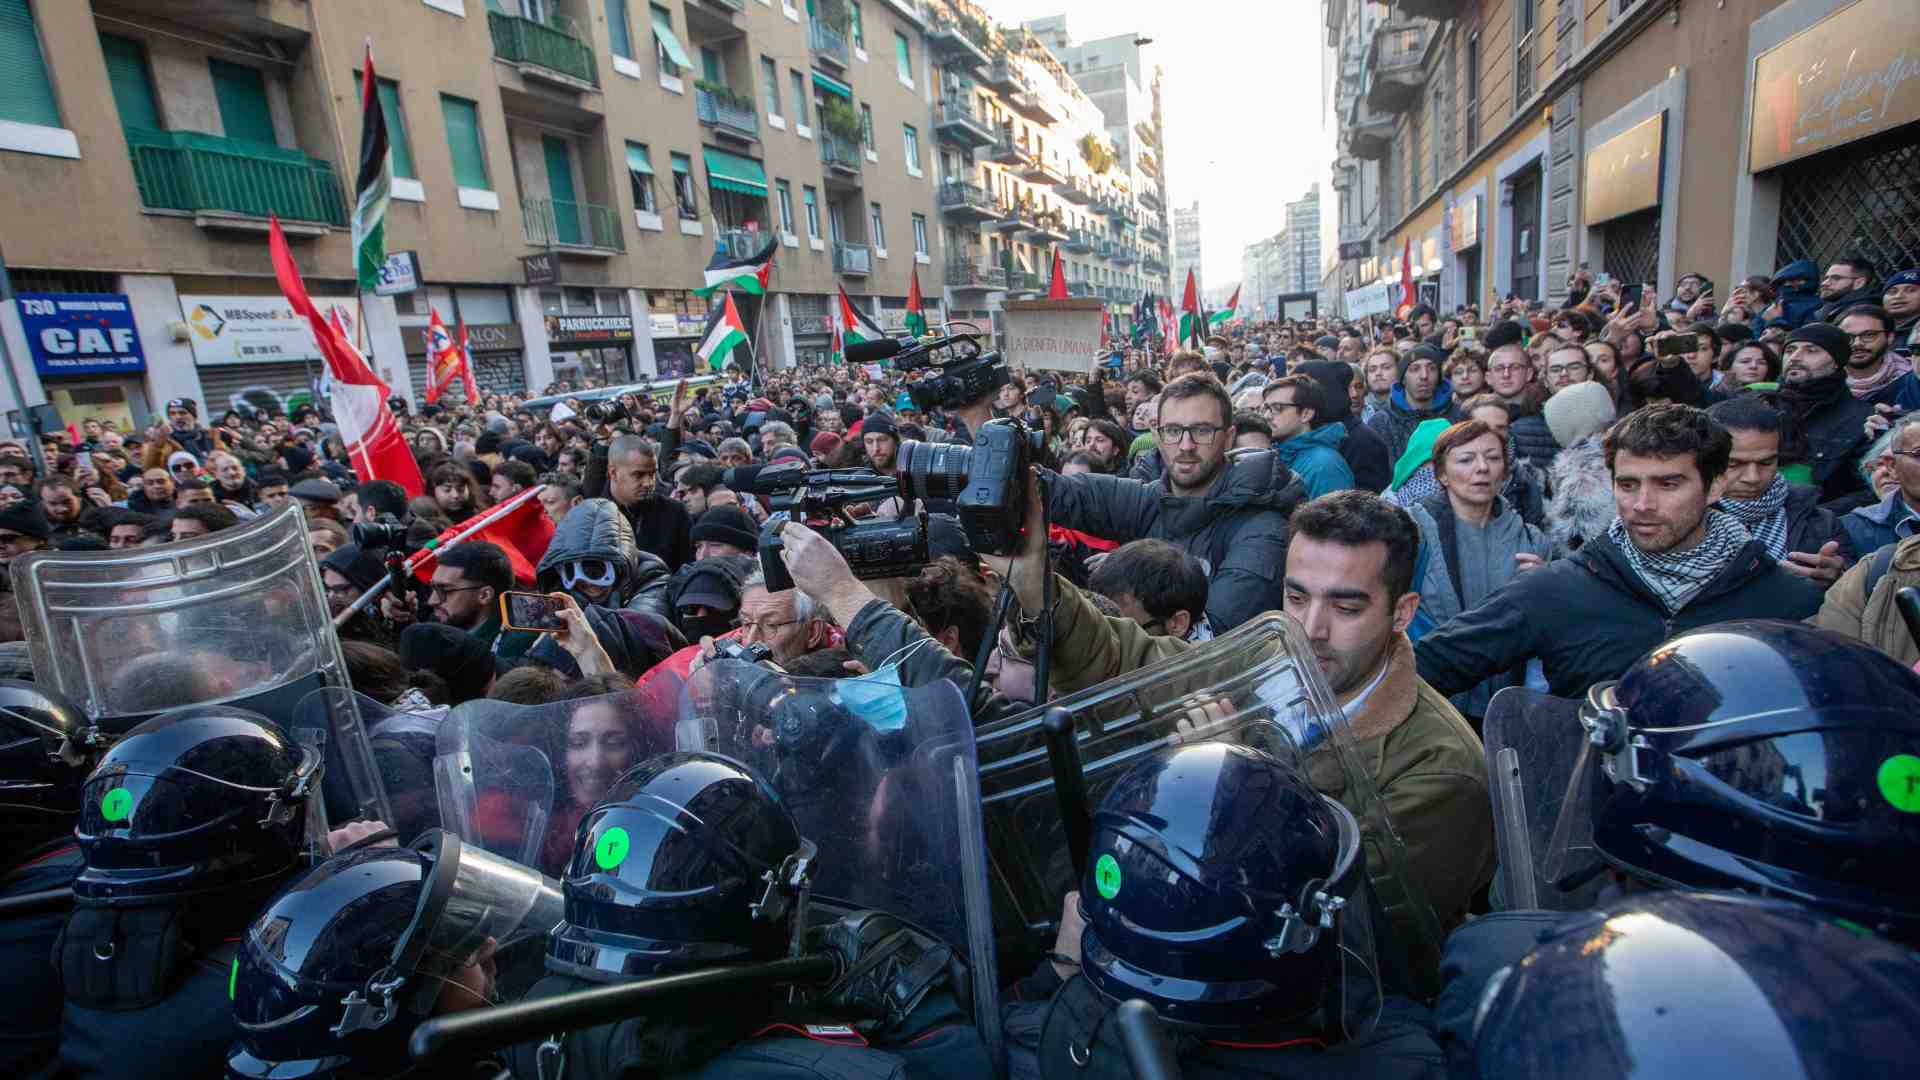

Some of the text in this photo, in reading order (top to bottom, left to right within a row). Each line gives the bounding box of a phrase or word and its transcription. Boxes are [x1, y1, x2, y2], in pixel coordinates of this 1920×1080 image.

[20, 299, 56, 315] 730
[559, 317, 633, 331] PARRUCCHIERE
[41, 327, 134, 355] CAF
[467, 327, 507, 341] ALON
